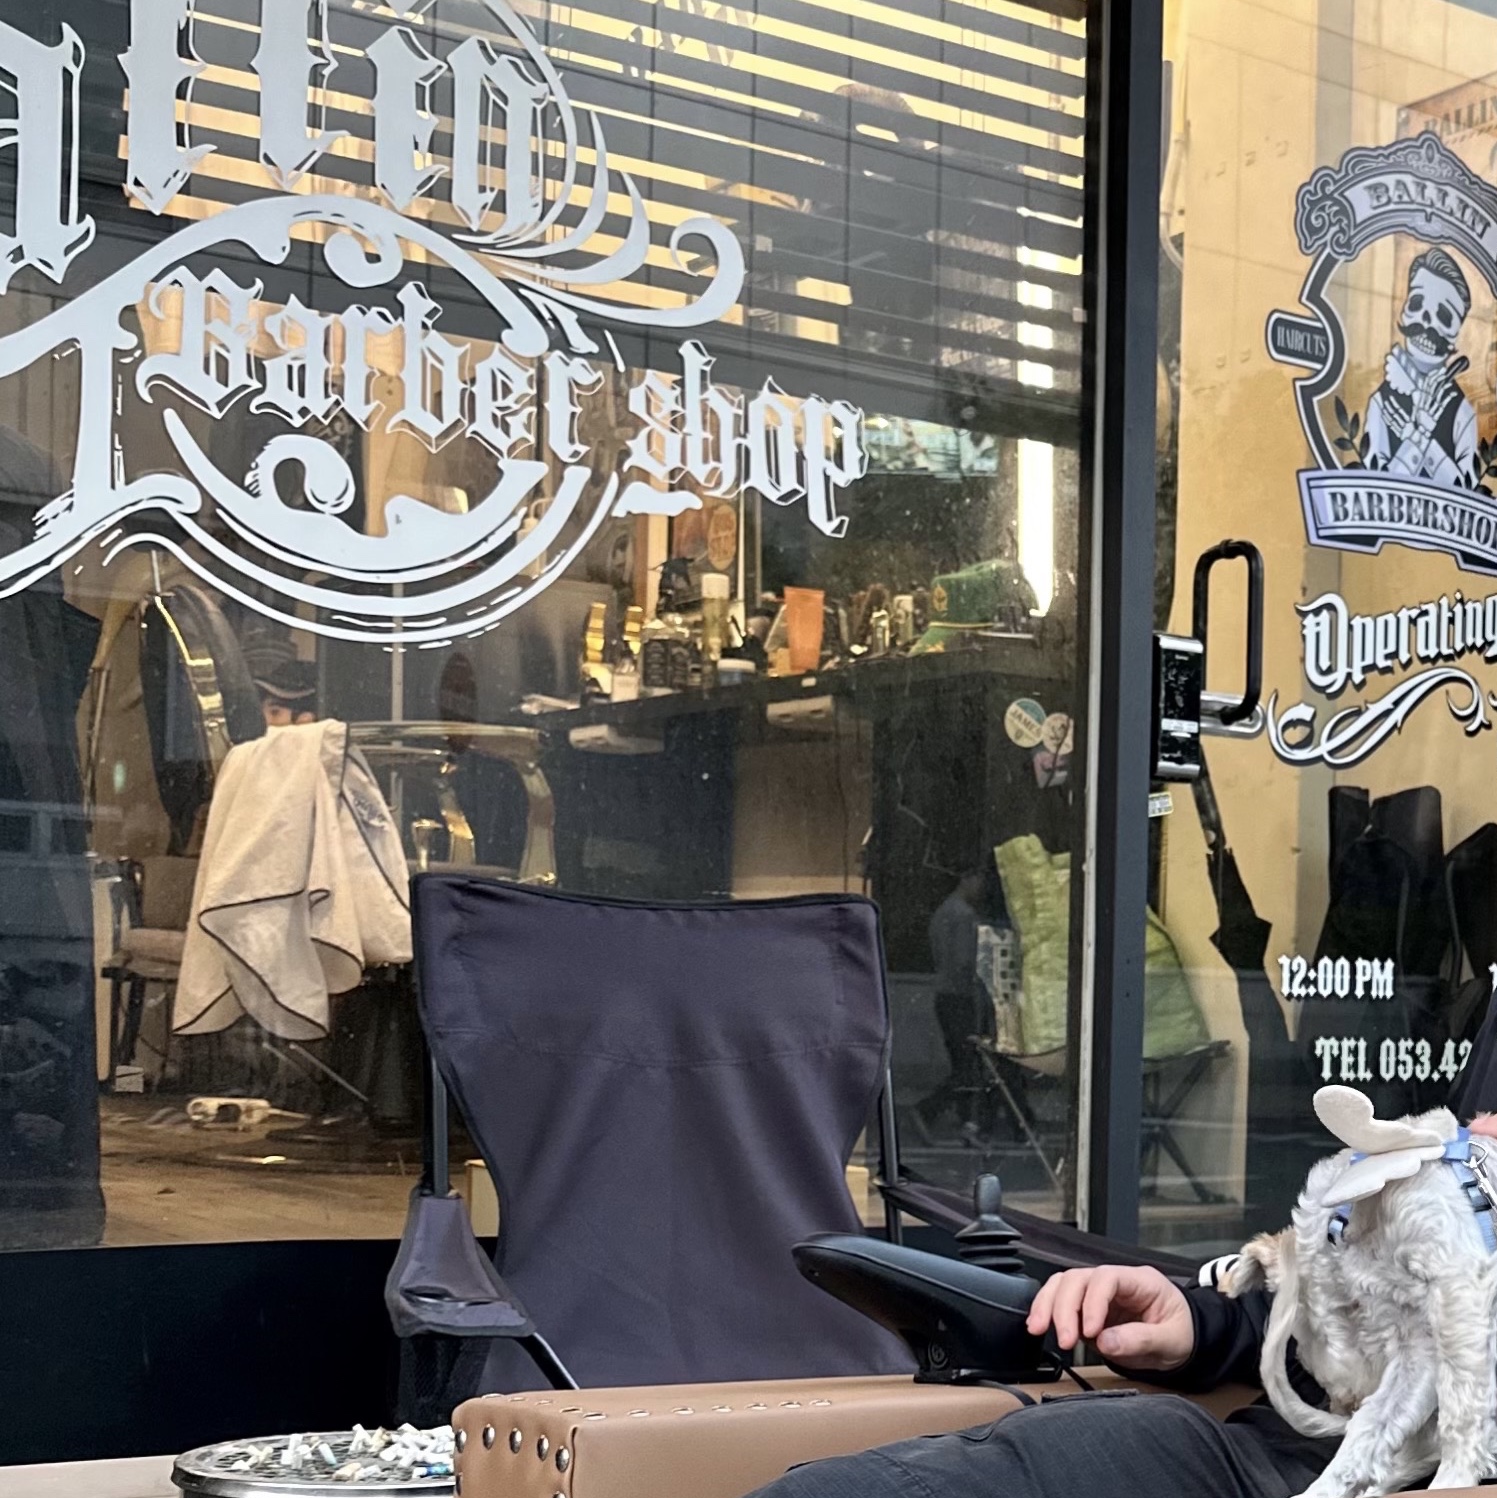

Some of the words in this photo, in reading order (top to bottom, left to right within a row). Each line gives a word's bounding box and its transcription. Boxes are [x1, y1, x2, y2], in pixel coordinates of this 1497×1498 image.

[1364, 178, 1492, 240] BALLIN
[135, 265, 605, 463] Barber
[623, 338, 869, 539] shop
[1277, 954, 1351, 998] 12:00
[1354, 956, 1395, 1000] PM
[1314, 1036, 1373, 1083] TEL
